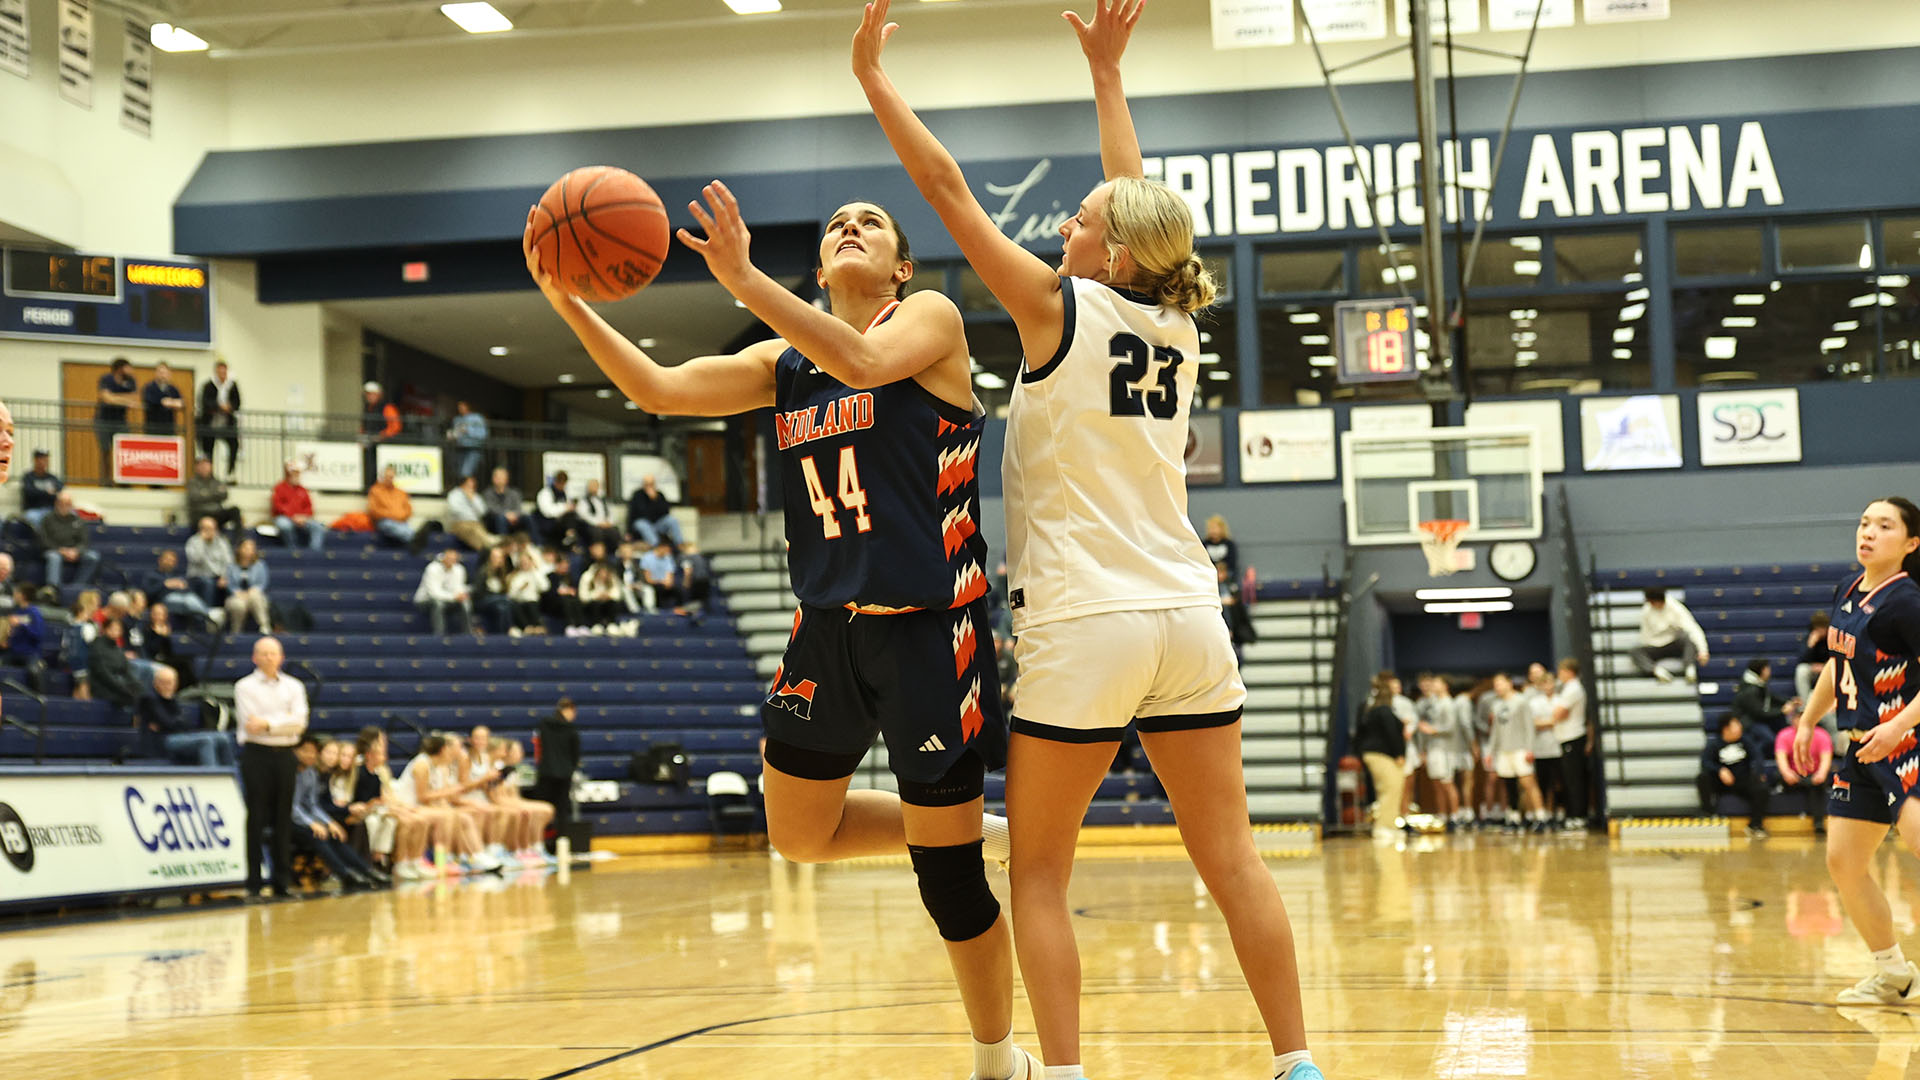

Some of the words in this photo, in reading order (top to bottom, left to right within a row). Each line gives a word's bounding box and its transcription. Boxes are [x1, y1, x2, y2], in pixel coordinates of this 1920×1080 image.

[1518, 121, 1784, 219] ARENA
[23, 306, 73, 326] PERIOD
[1108, 331, 1184, 420] 23
[1368, 331, 1404, 374] 18
[1713, 402, 1786, 443] SDC
[801, 445, 873, 539] 44
[29, 824, 102, 848] BROTHERS
[125, 785, 231, 854] Cattle
